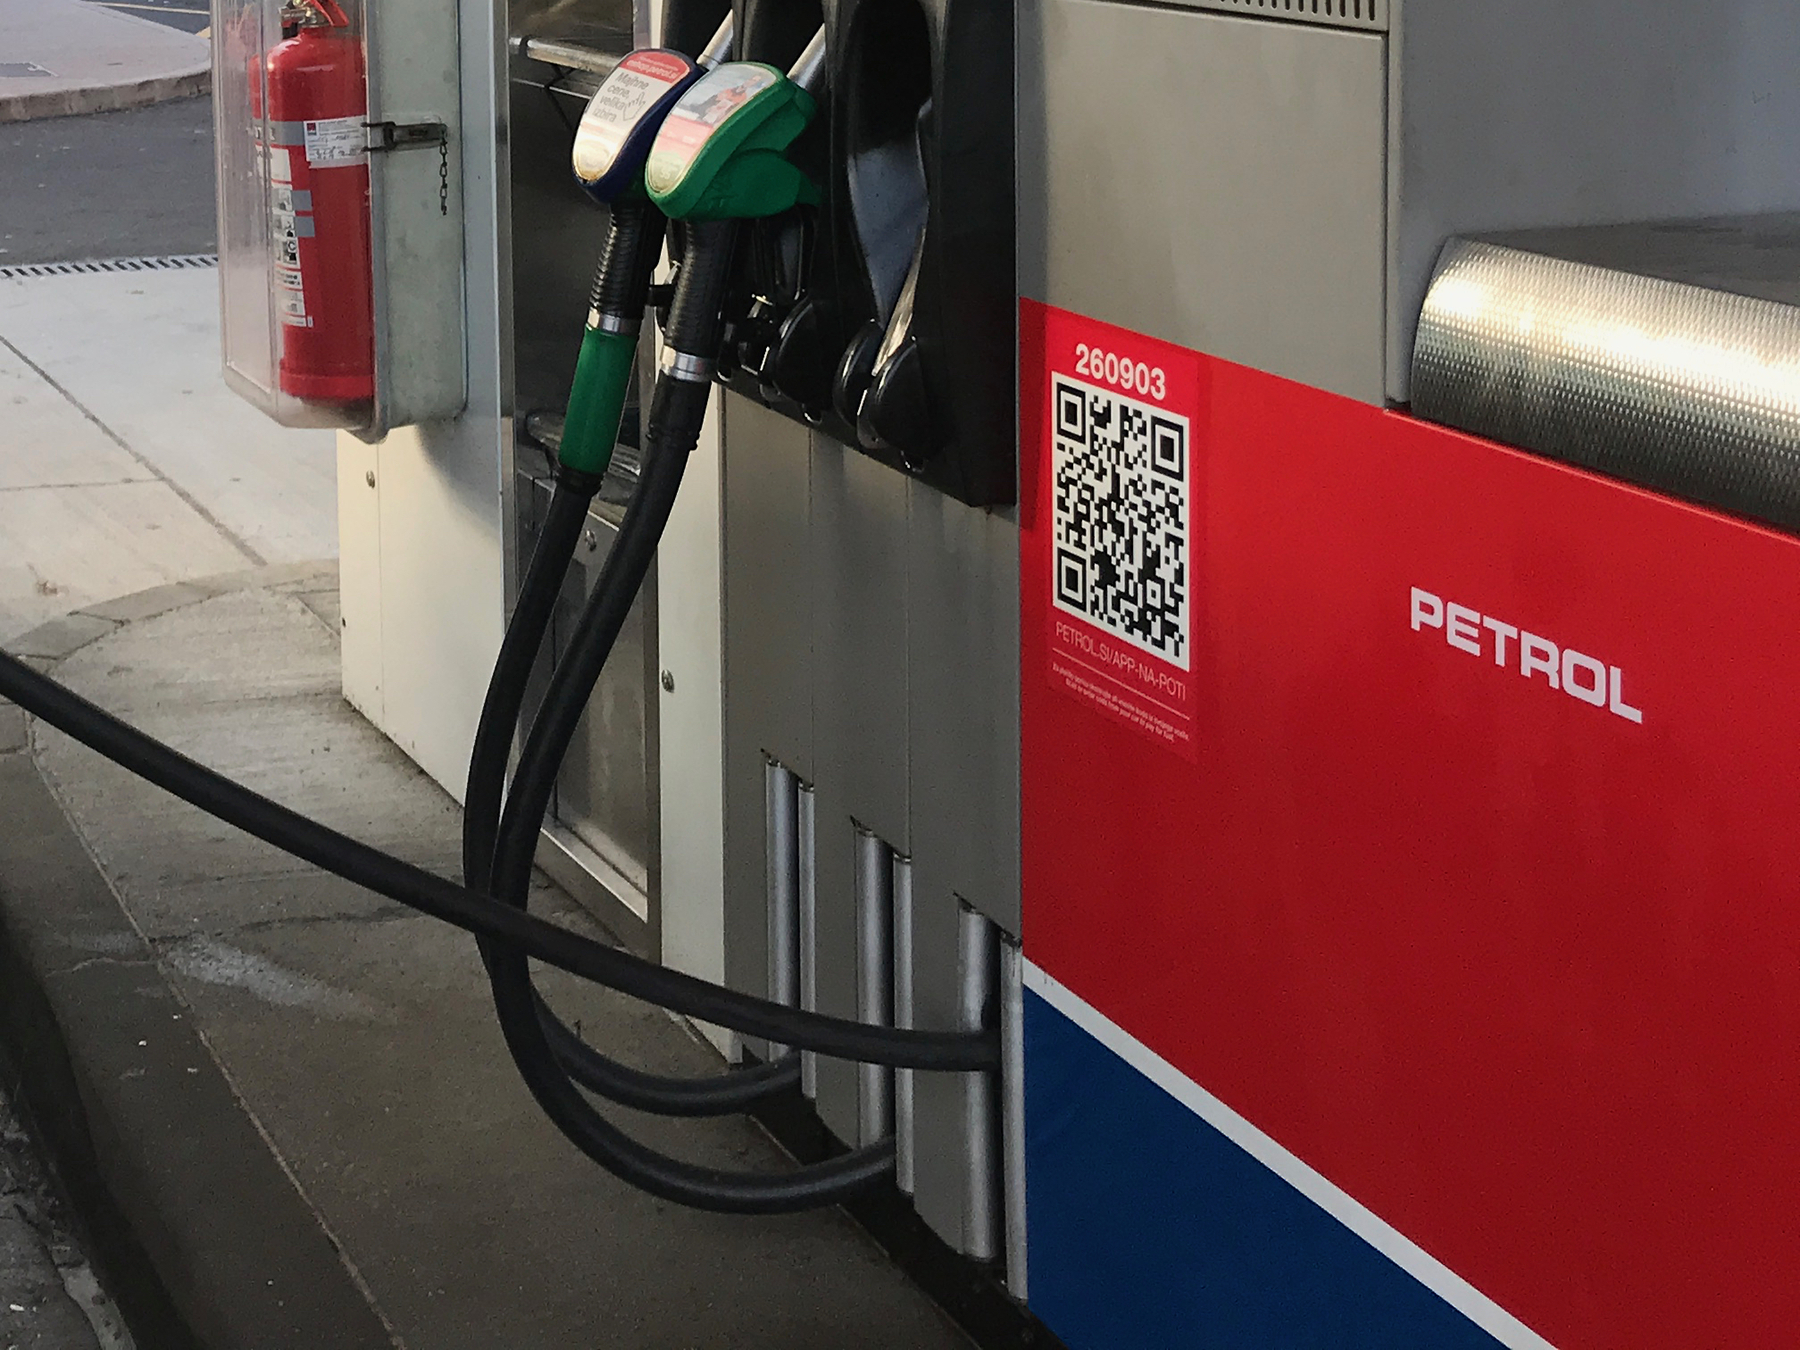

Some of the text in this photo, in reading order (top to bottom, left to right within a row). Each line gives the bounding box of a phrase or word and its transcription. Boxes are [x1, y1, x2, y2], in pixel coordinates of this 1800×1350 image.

[615, 72, 650, 90] Majhne
[592, 108, 617, 123] izbira
[599, 96, 625, 111] velika
[1075, 343, 1166, 401] 260903
[1055, 621, 1187, 701] PETROL.SI/APP-NA-POTI
[1411, 586, 1642, 725] PETROL
